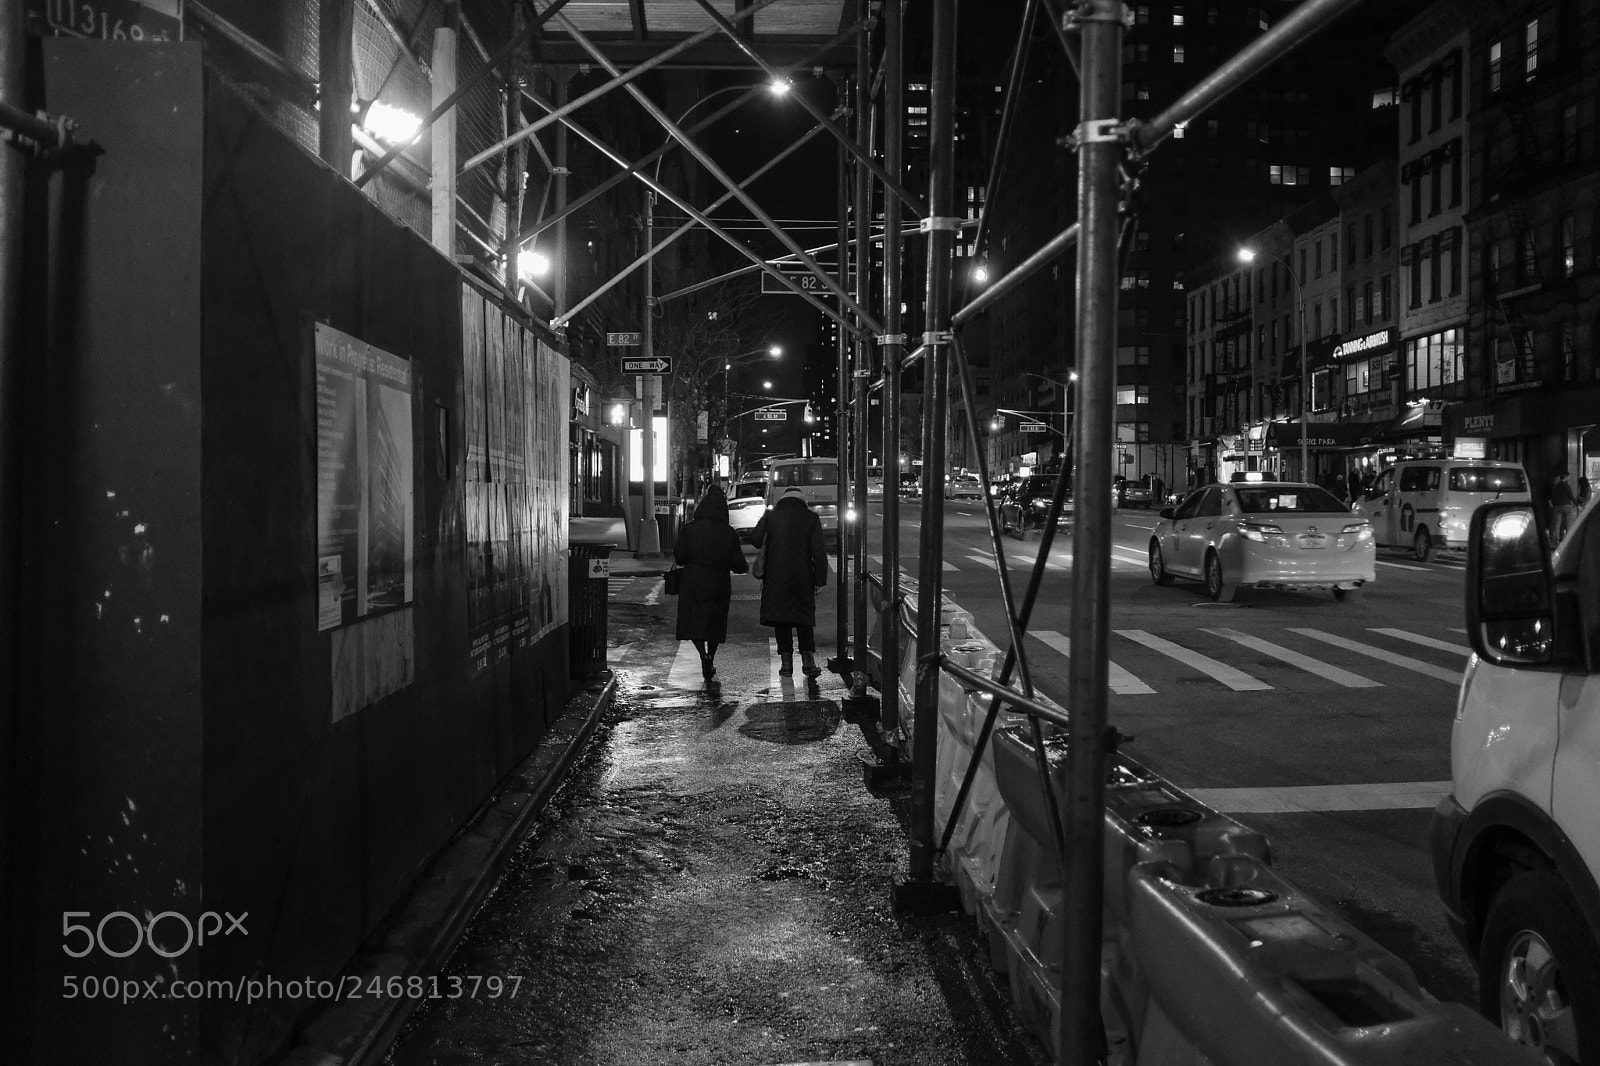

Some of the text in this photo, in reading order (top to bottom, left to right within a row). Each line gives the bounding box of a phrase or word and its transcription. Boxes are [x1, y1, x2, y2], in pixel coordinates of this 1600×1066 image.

[801, 276, 817, 289] 82
[609, 334, 615, 344] E
[618, 334, 630, 344] 82
[1464, 414, 1495, 429] PLENTY
